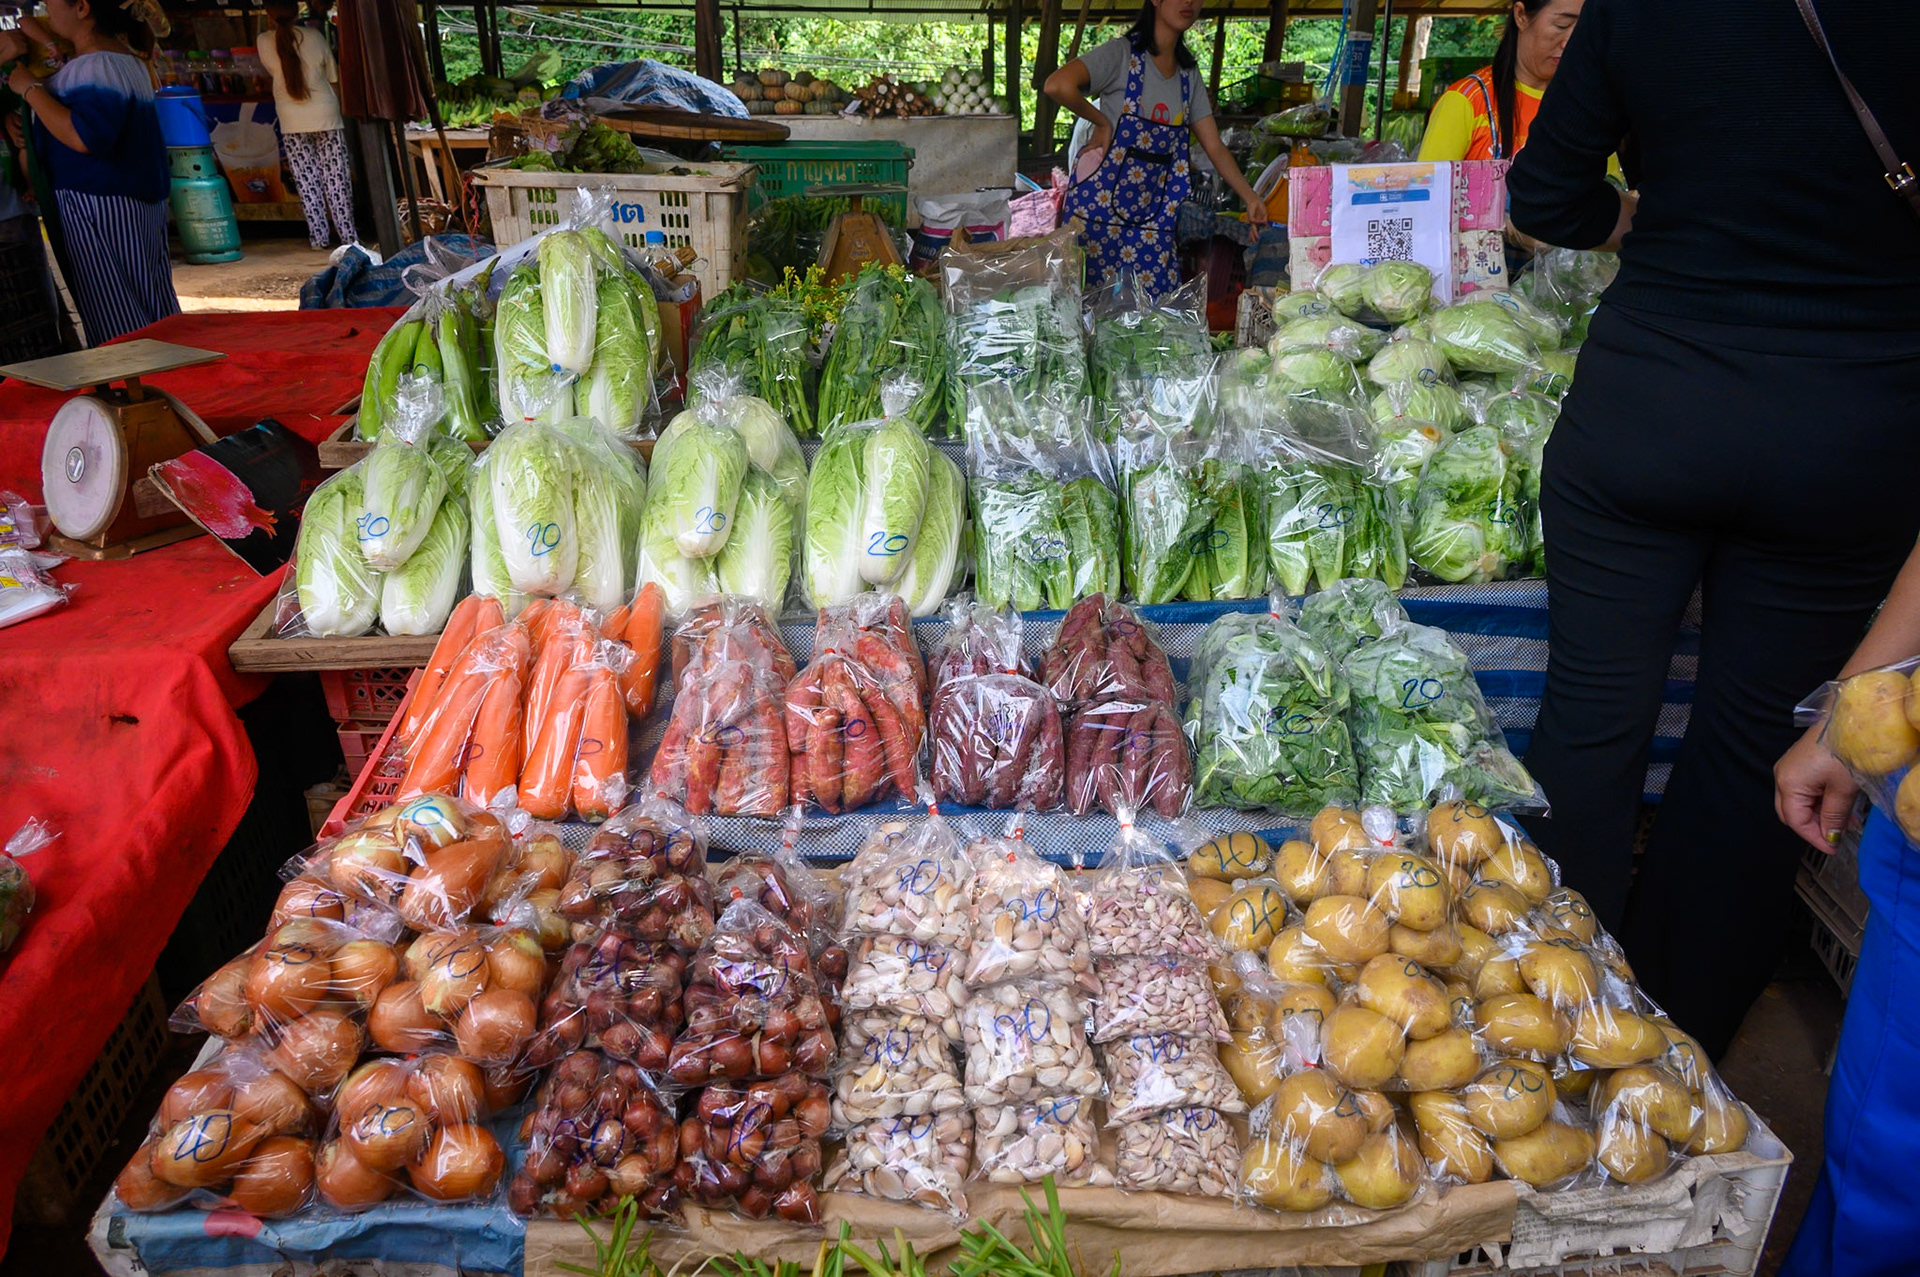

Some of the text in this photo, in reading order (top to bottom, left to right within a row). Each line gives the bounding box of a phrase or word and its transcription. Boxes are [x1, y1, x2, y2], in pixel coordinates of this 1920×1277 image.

[786, 161, 855, 186] กาญจนา
[695, 506, 727, 535] 20
[1316, 503, 1355, 529] 20
[526, 522, 562, 557] 20
[867, 531, 909, 557] 20
[1402, 678, 1444, 709] 20
[1264, 705, 1314, 735] 20
[1453, 801, 1490, 823] 20
[1197, 831, 1259, 872] 20
[896, 859, 941, 896] 20
[1400, 860, 1440, 889] 20
[1006, 888, 1059, 923] 20
[896, 938, 950, 973] 20
[993, 998, 1050, 1043] 20
[863, 1026, 911, 1065] 20
[1131, 1032, 1184, 1062] 20
[1497, 1066, 1544, 1100] 20
[358, 1102, 416, 1140] 20
